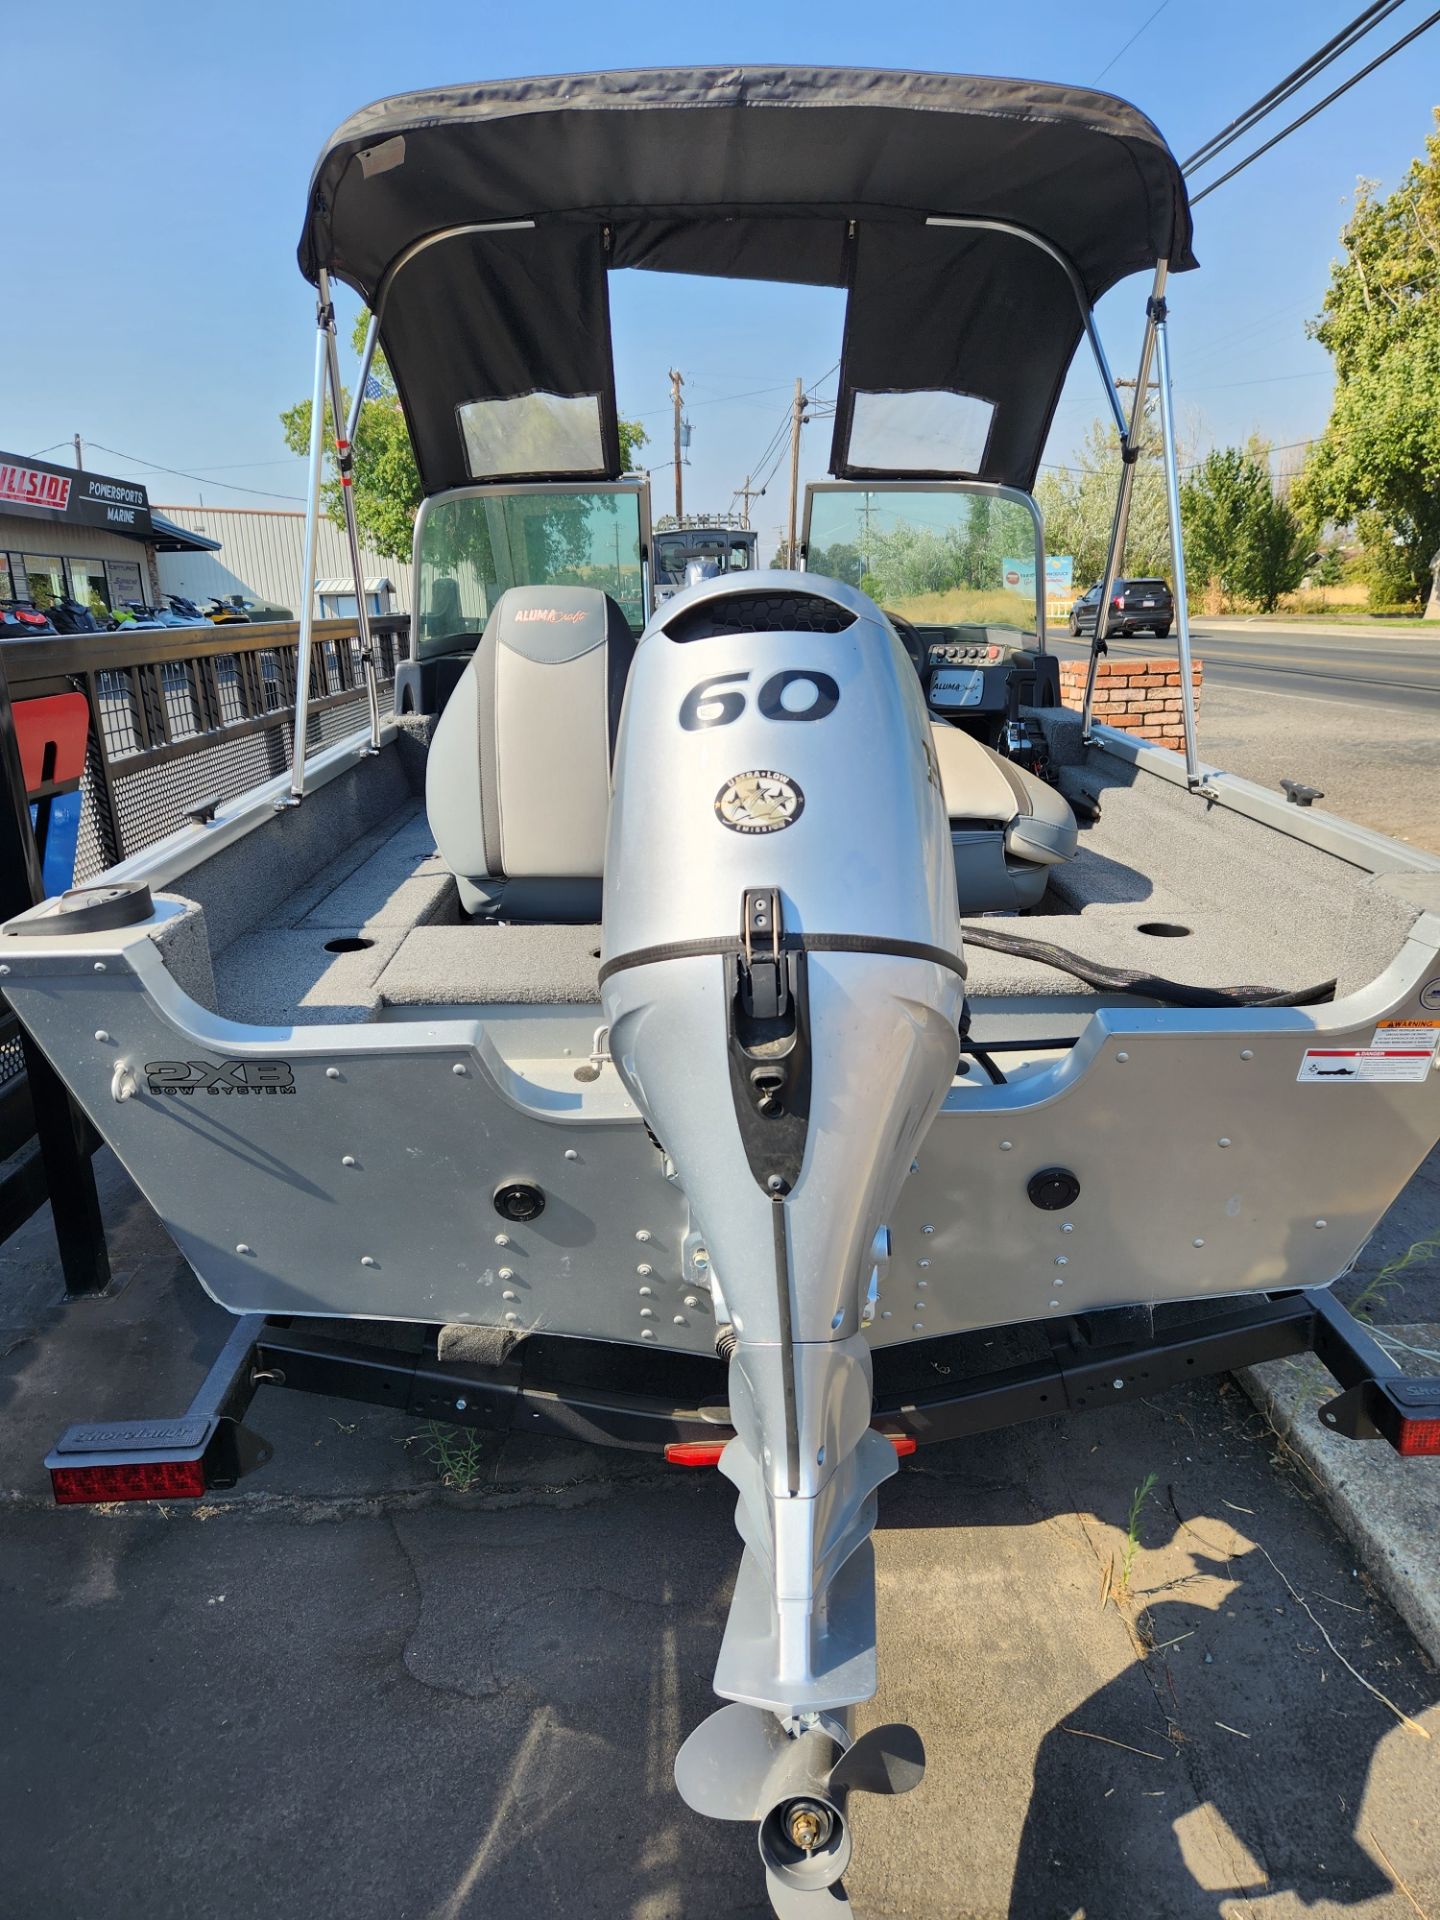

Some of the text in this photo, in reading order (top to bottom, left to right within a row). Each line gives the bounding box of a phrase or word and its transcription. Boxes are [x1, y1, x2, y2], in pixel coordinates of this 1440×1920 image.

[89, 481, 143, 504] POWERSPORTS
[107, 507, 135, 524] MARINE
[678, 669, 840, 732] 60
[144, 1060, 295, 1088] 2XB
[150, 1086, 297, 1095] BOW SYSTEM
